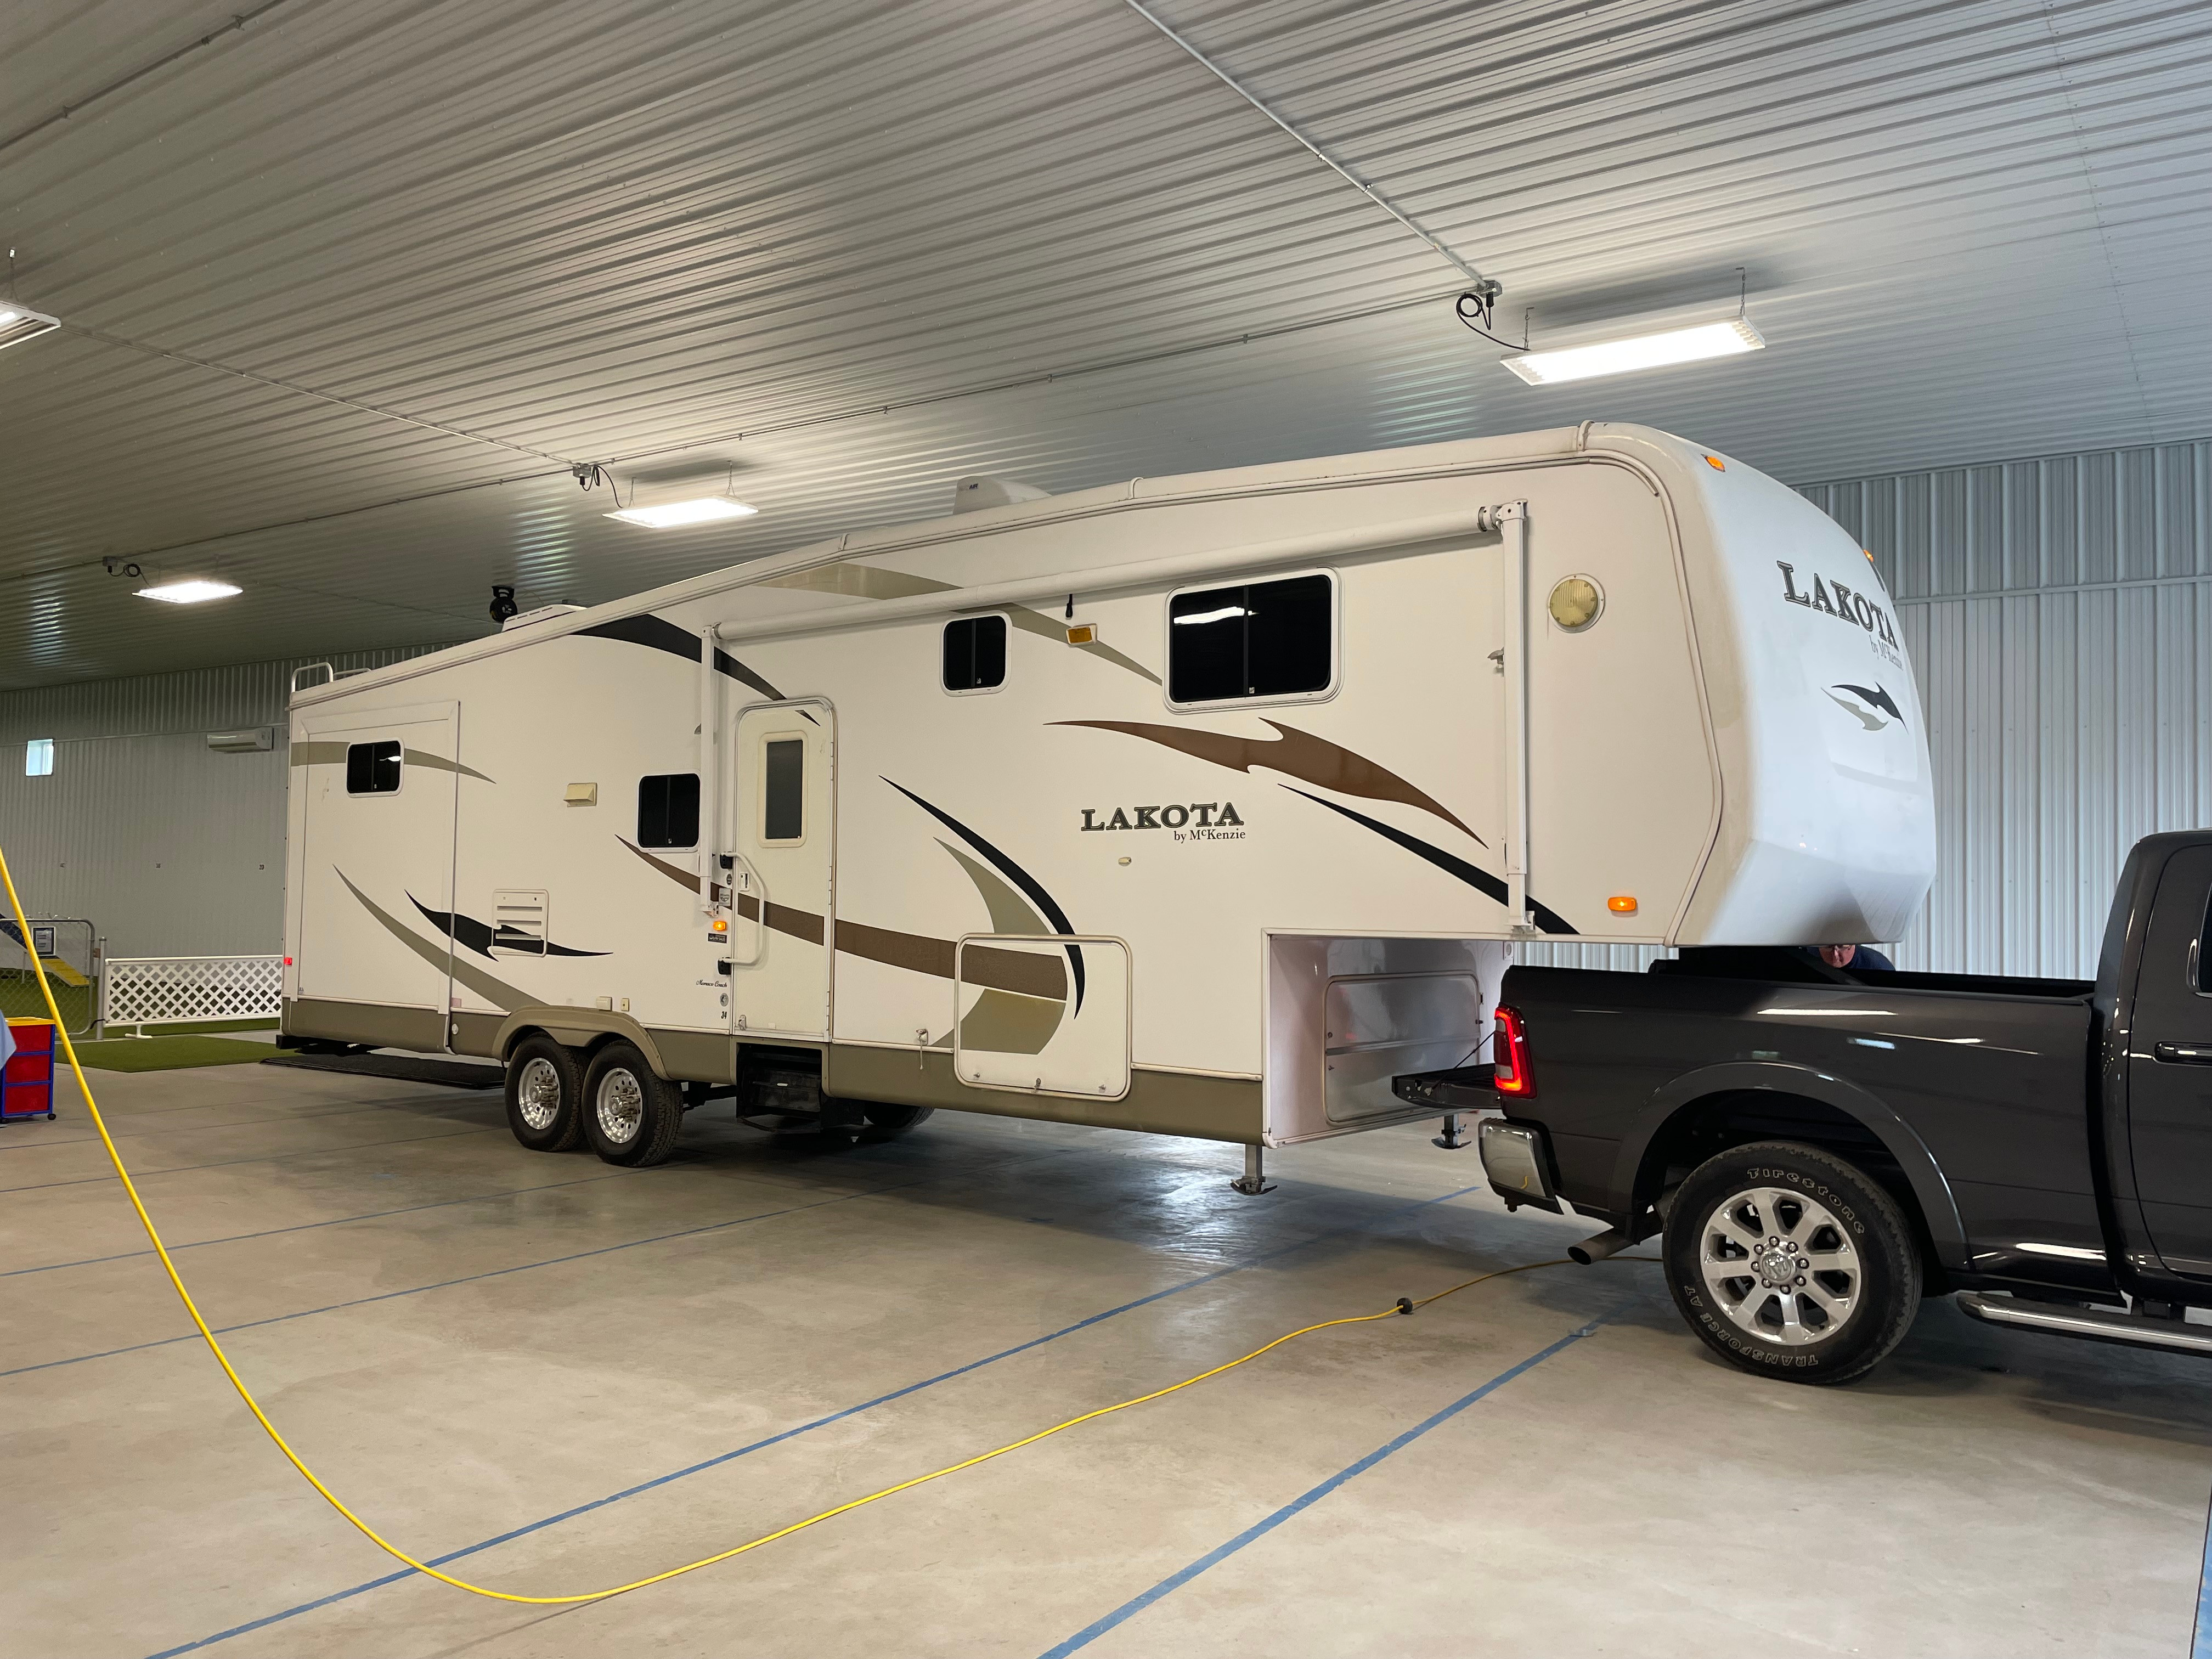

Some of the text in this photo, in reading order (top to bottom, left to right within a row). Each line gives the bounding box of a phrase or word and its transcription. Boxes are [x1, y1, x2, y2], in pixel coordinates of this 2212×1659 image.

[1776, 560, 1899, 652] LAKOTA
[1869, 634, 1879, 660] by
[1081, 802, 1245, 832] LAKOTA
[1173, 828, 1246, 844] by McKenzie
[1747, 1167, 1865, 1234] Firestone
[1684, 1285, 1819, 1367] TRANSFORCE AT
